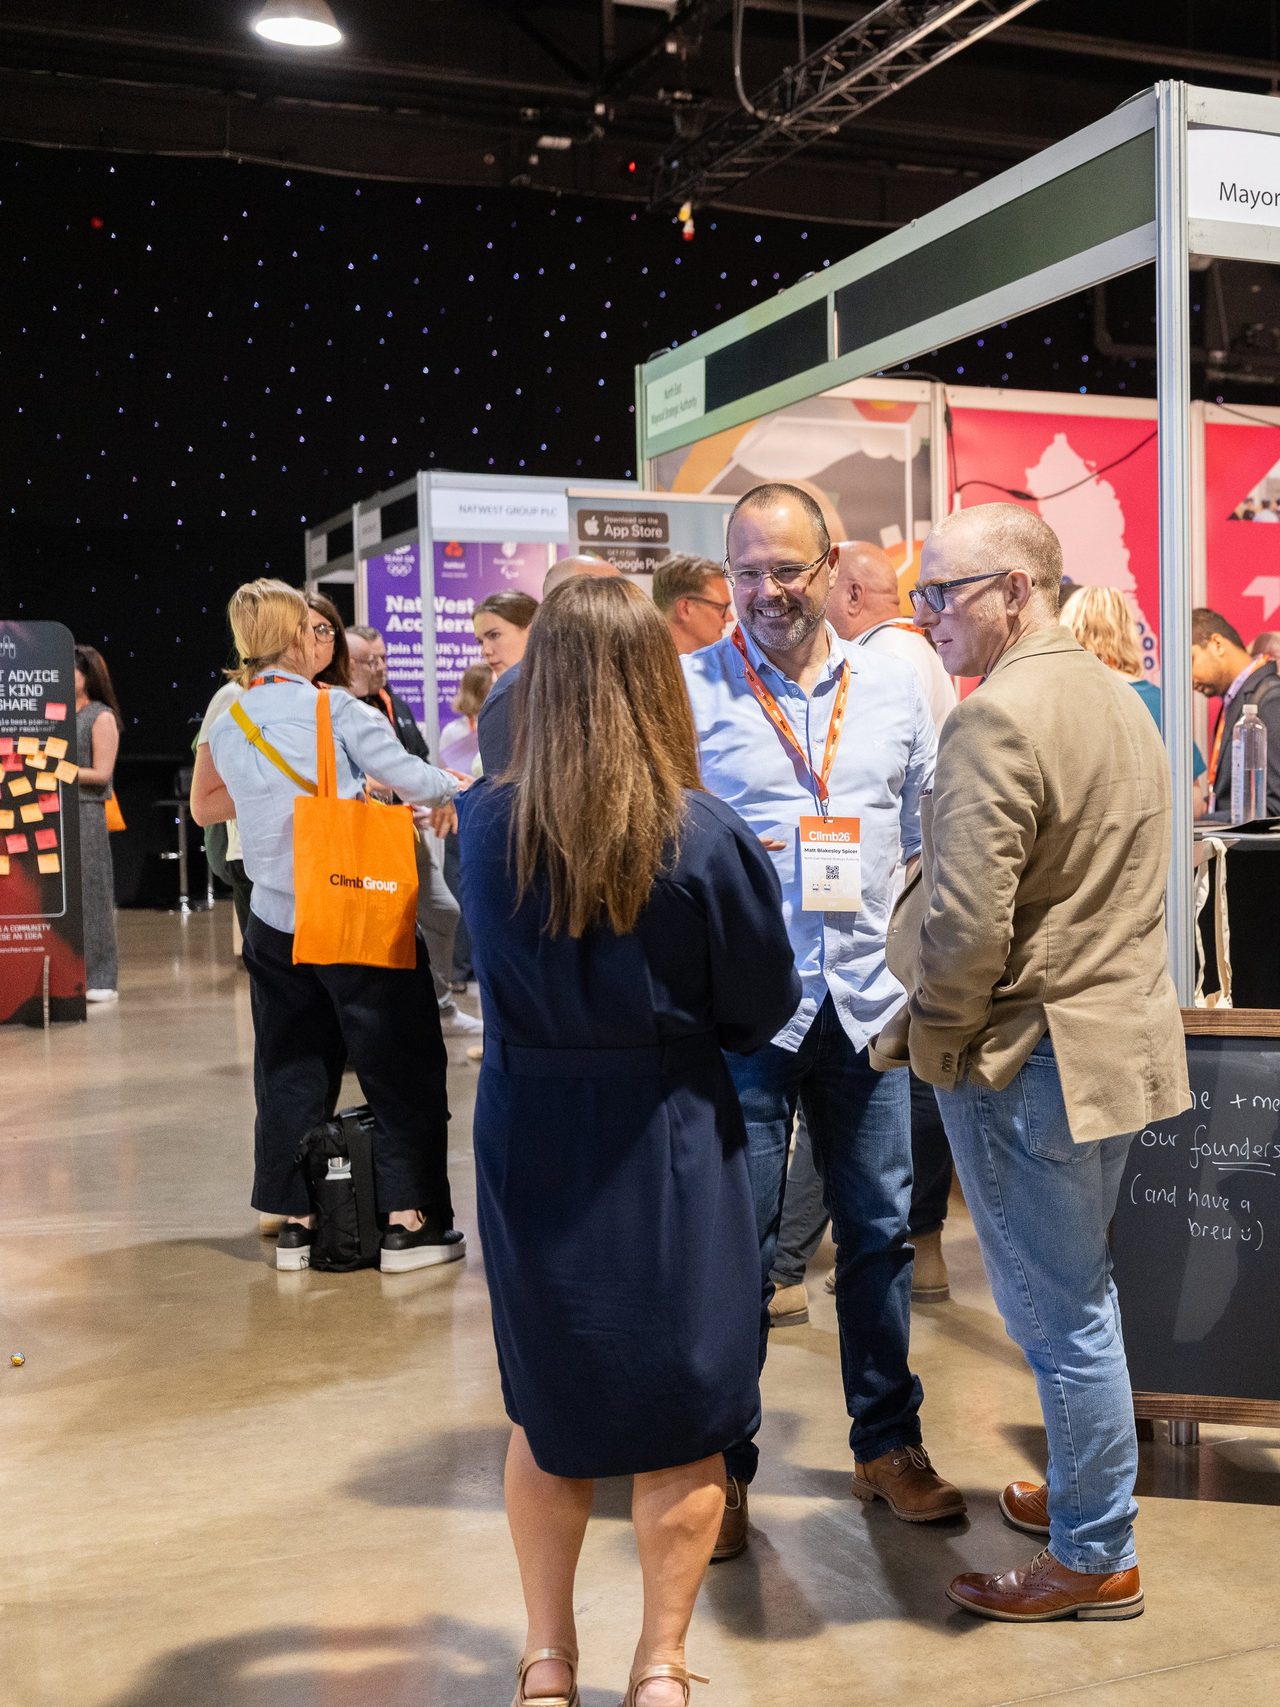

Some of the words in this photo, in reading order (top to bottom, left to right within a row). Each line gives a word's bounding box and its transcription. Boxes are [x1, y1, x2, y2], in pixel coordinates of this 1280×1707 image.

[459, 503, 503, 514] NATWEST
[505, 505, 539, 516] GROUP
[540, 506, 557, 517] PLC
[604, 515, 637, 524] Download
[647, 516, 659, 524] the
[604, 525, 630, 539] App
[631, 525, 663, 539] Store
[608, 557, 644, 571] Google
[385, 614, 475, 633] Acclera
[387, 642, 411, 656] Join
[412, 642, 424, 655] th
[8, 669, 60, 683] ADVICE
[9, 683, 44, 697] KIND
[808, 831, 850, 842] Climb26
[10, 923, 51, 934] COMMUNITY
[13, 932, 24, 941] AN
[24, 932, 43, 940] IDEA
[1130, 1173, 1177, 1207] (and
[1188, 1187, 1230, 1211] have
[1240, 1199, 1251, 1213] a
